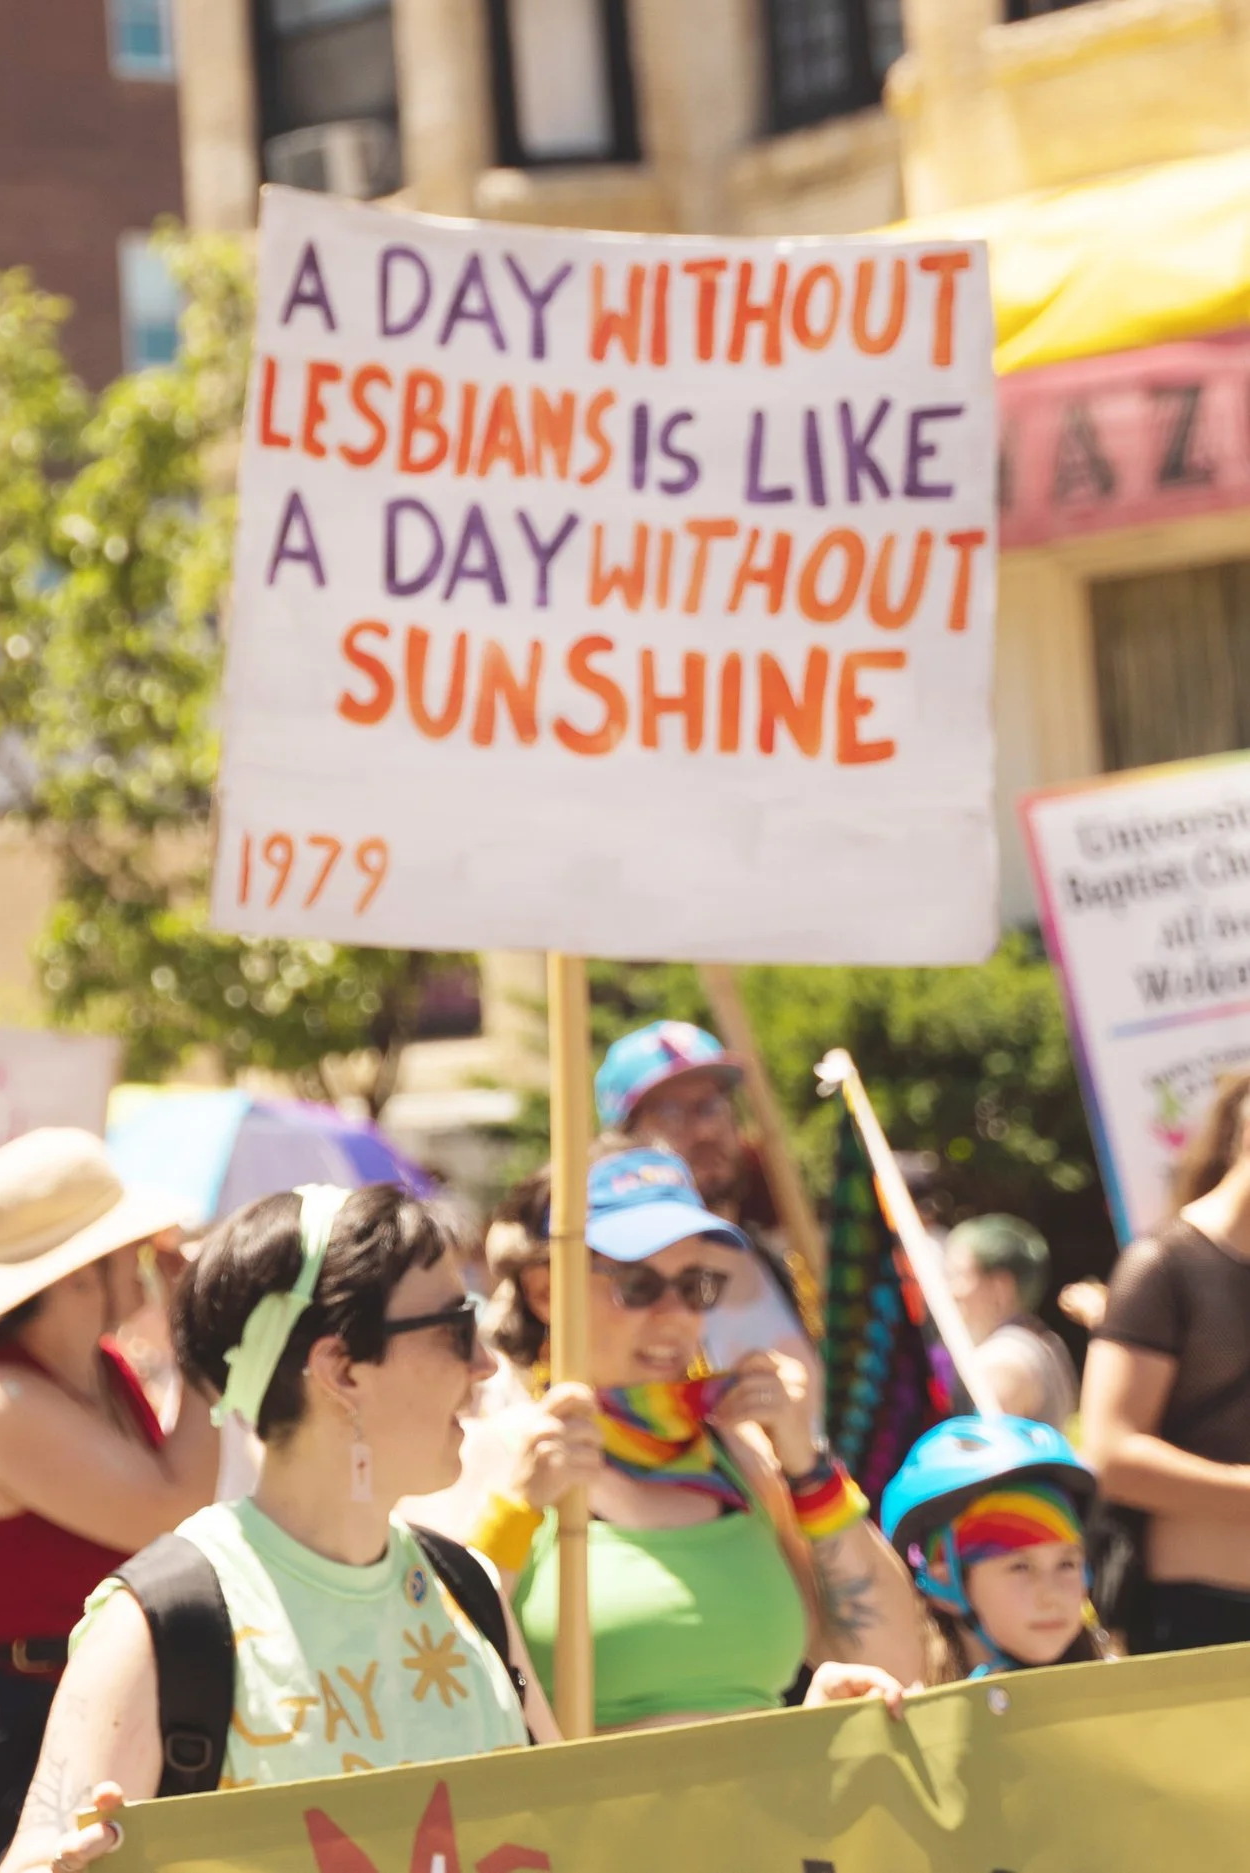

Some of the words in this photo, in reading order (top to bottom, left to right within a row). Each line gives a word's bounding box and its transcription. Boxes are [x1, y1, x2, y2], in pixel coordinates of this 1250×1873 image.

[281, 240, 337, 334] A
[379, 245, 575, 361] DAY
[588, 250, 973, 368] WITHOUT
[258, 355, 617, 486] LESBIANS
[633, 400, 702, 495] IS
[746, 397, 966, 508] LIKE
[267, 489, 328, 590] A
[384, 496, 580, 610] DAY
[588, 518, 988, 634] WITHOUT
[337, 619, 908, 767] SUNSHINE
[236, 831, 391, 916] 1979
